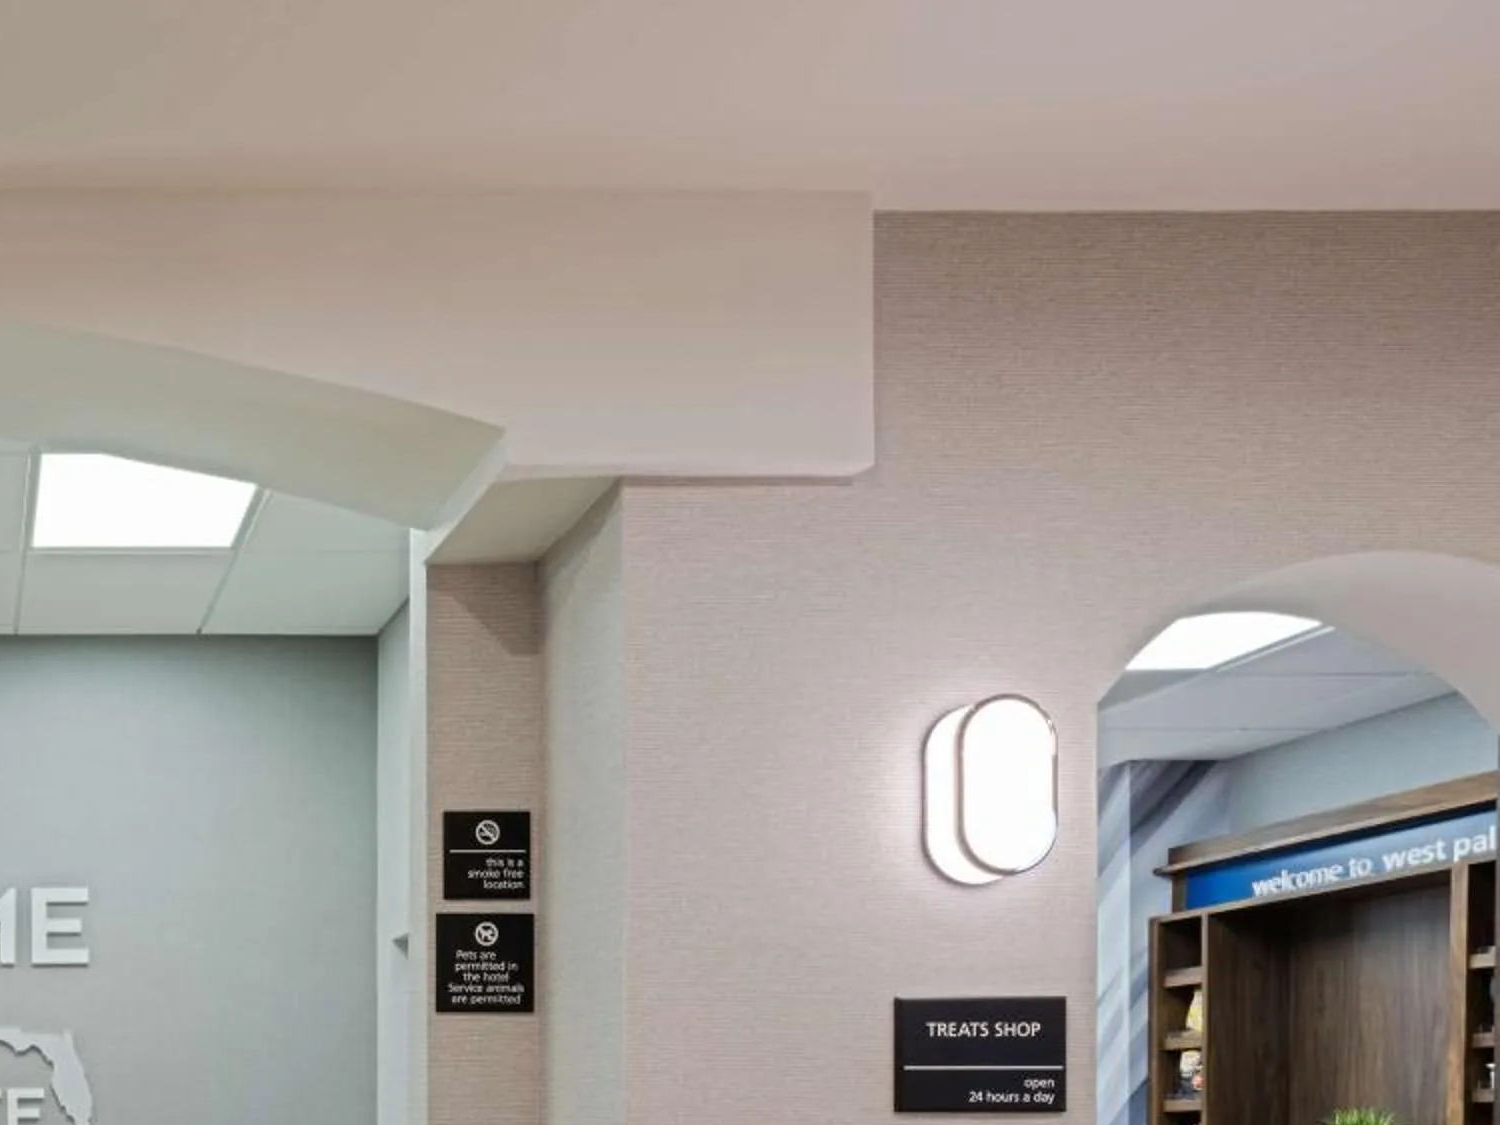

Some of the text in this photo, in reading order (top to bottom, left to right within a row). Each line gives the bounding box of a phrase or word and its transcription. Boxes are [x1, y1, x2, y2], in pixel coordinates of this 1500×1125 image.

[486, 858, 505, 867] this
[507, 858, 514, 867] is
[1251, 863, 1344, 897] welcome
[1348, 857, 1373, 878] to
[1381, 838, 1447, 869] west
[468, 868, 524, 878] smoke free
[455, 950, 497, 960] Pets are
[455, 962, 505, 972] permitted
[463, 972, 509, 982] the hotel
[448, 983, 525, 992] Service animals
[452, 994, 521, 1005] are permitted
[926, 1021, 1041, 1037] TREATS SHOP
[1024, 1079, 1055, 1090] open
[968, 1090, 1055, 1104] 24 hours a day
